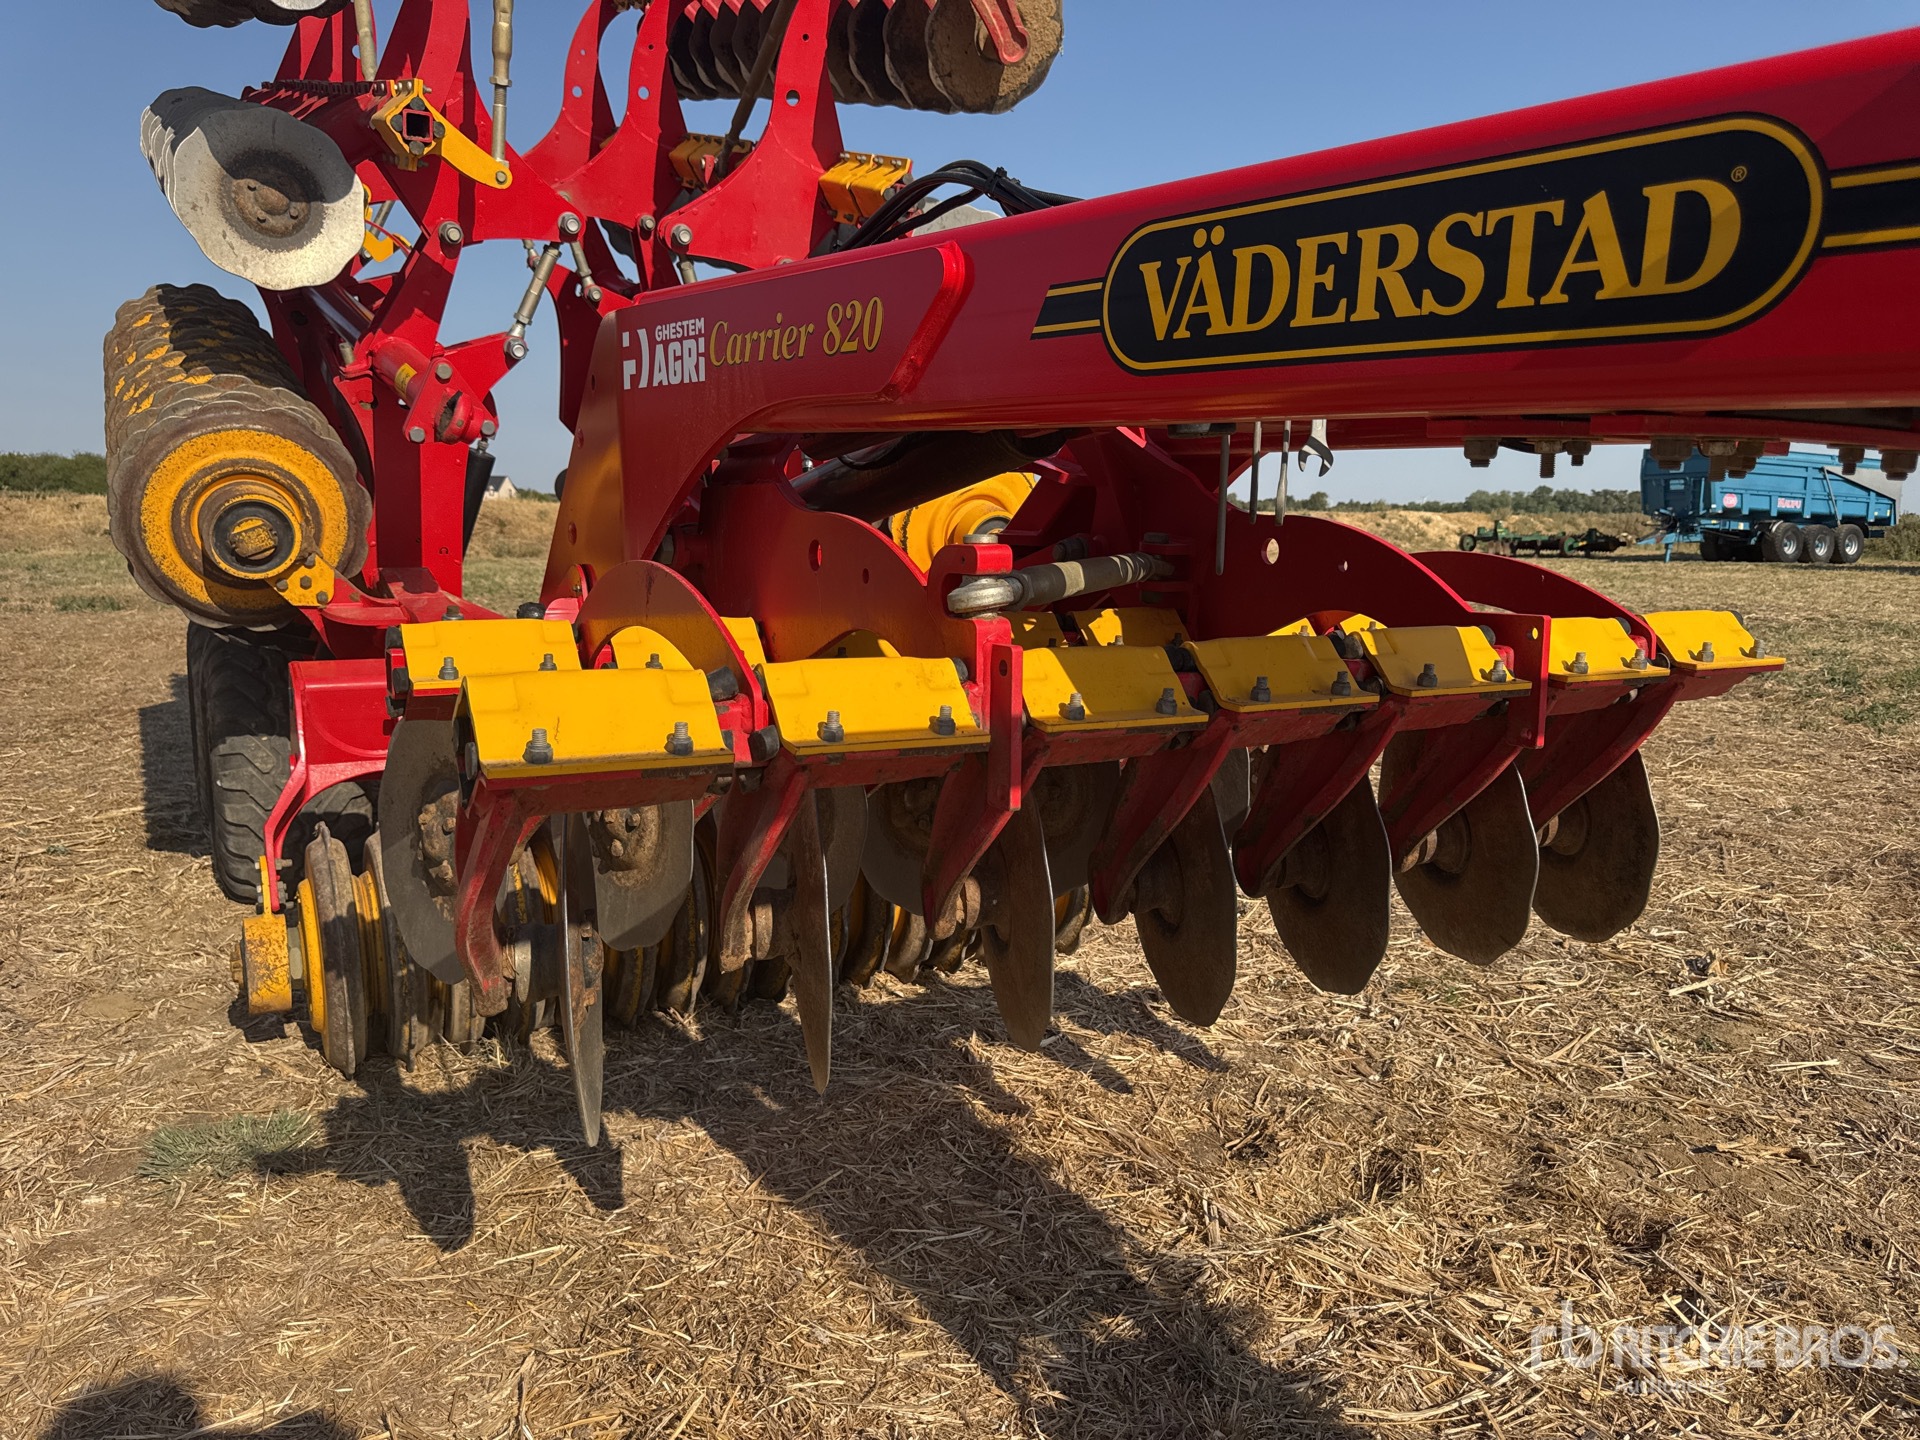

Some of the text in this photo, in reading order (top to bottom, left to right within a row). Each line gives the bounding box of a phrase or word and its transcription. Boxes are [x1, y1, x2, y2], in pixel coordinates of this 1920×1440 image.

[655, 318, 704, 341] GHESTEM
[710, 297, 883, 367] Carrier 820
